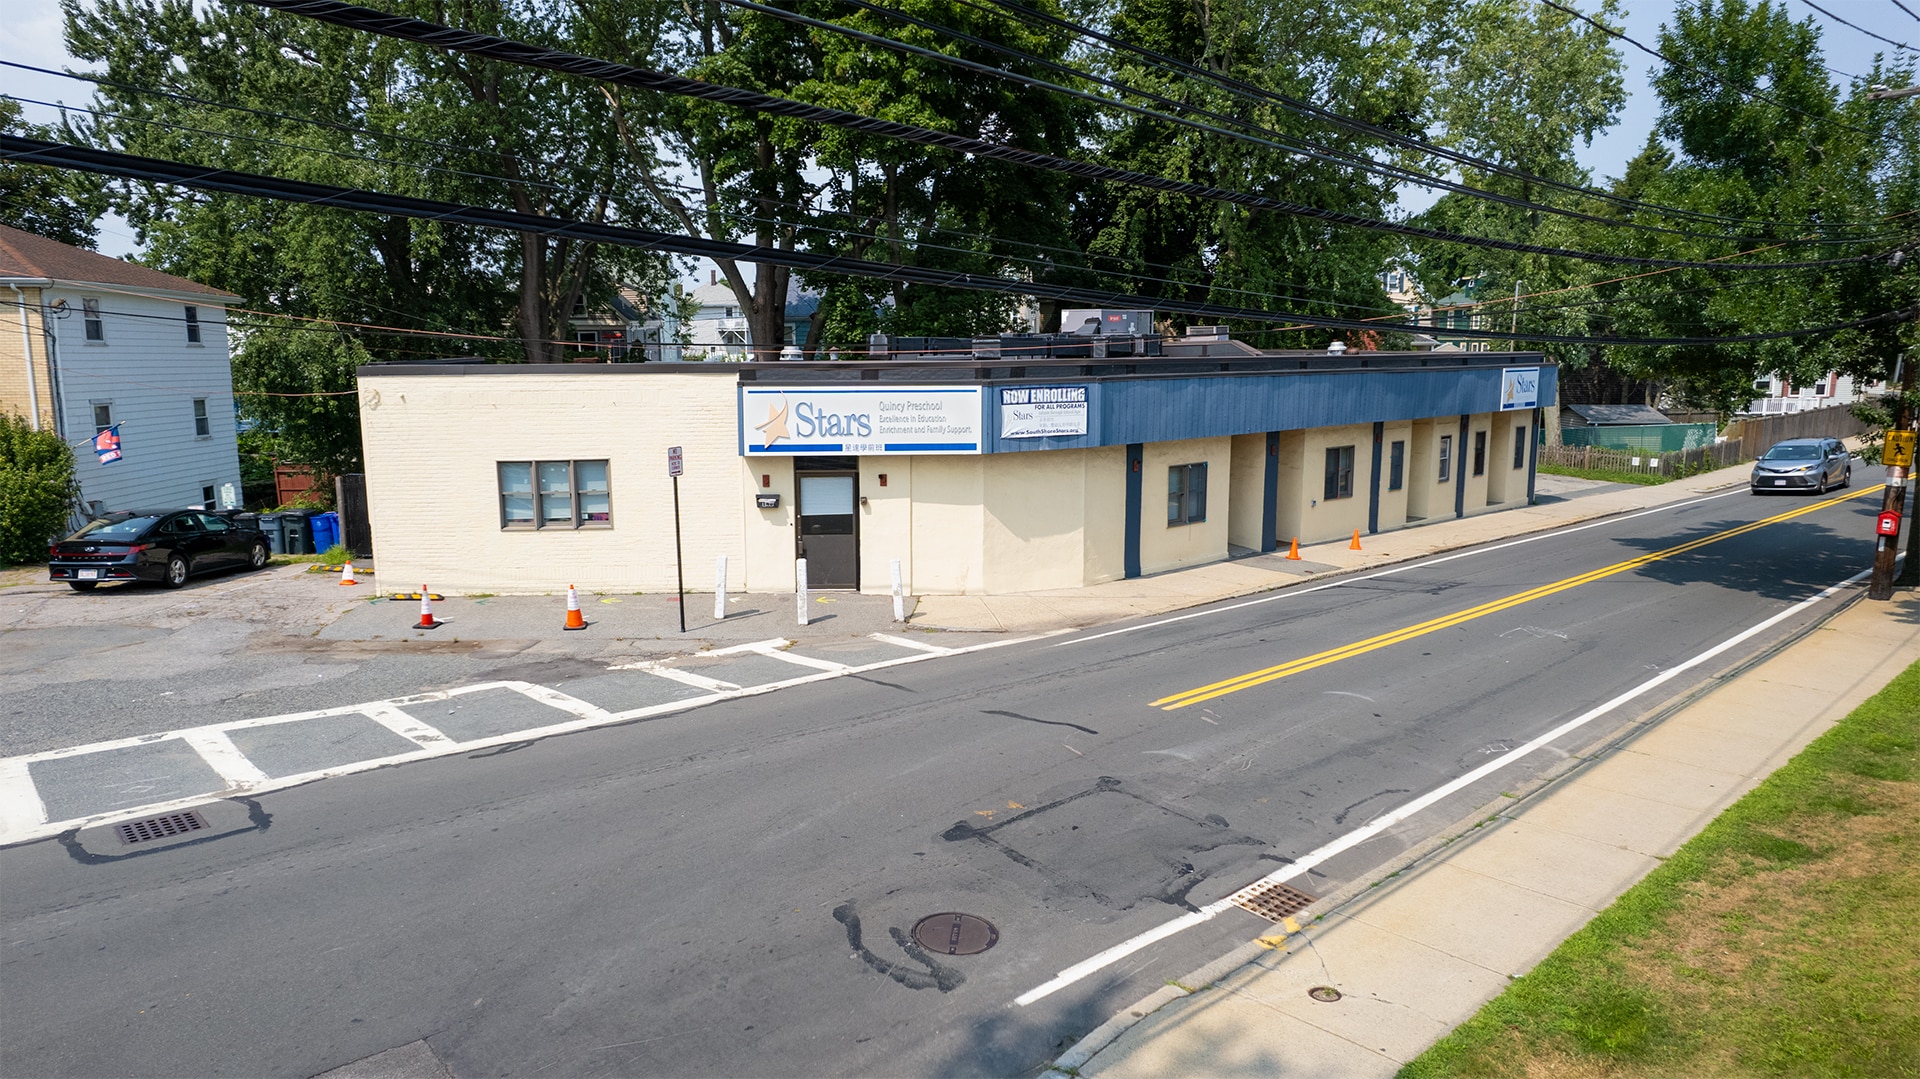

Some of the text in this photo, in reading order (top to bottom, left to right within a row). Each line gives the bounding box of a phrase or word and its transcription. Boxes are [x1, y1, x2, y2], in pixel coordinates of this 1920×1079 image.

[1516, 373, 1535, 393] Stars
[1003, 388, 1085, 404] NOW ENROLLING
[879, 401, 942, 413] Quincy Preschool
[795, 402, 872, 437] Stars
[879, 414, 947, 423] Excellence in Education
[1013, 410, 1033, 420] Stars
[879, 426, 913, 434] Enrichment
[914, 426, 926, 434] and
[927, 425, 946, 435] Family
[1010, 428, 1079, 436] www.SouthShoreStars.org
